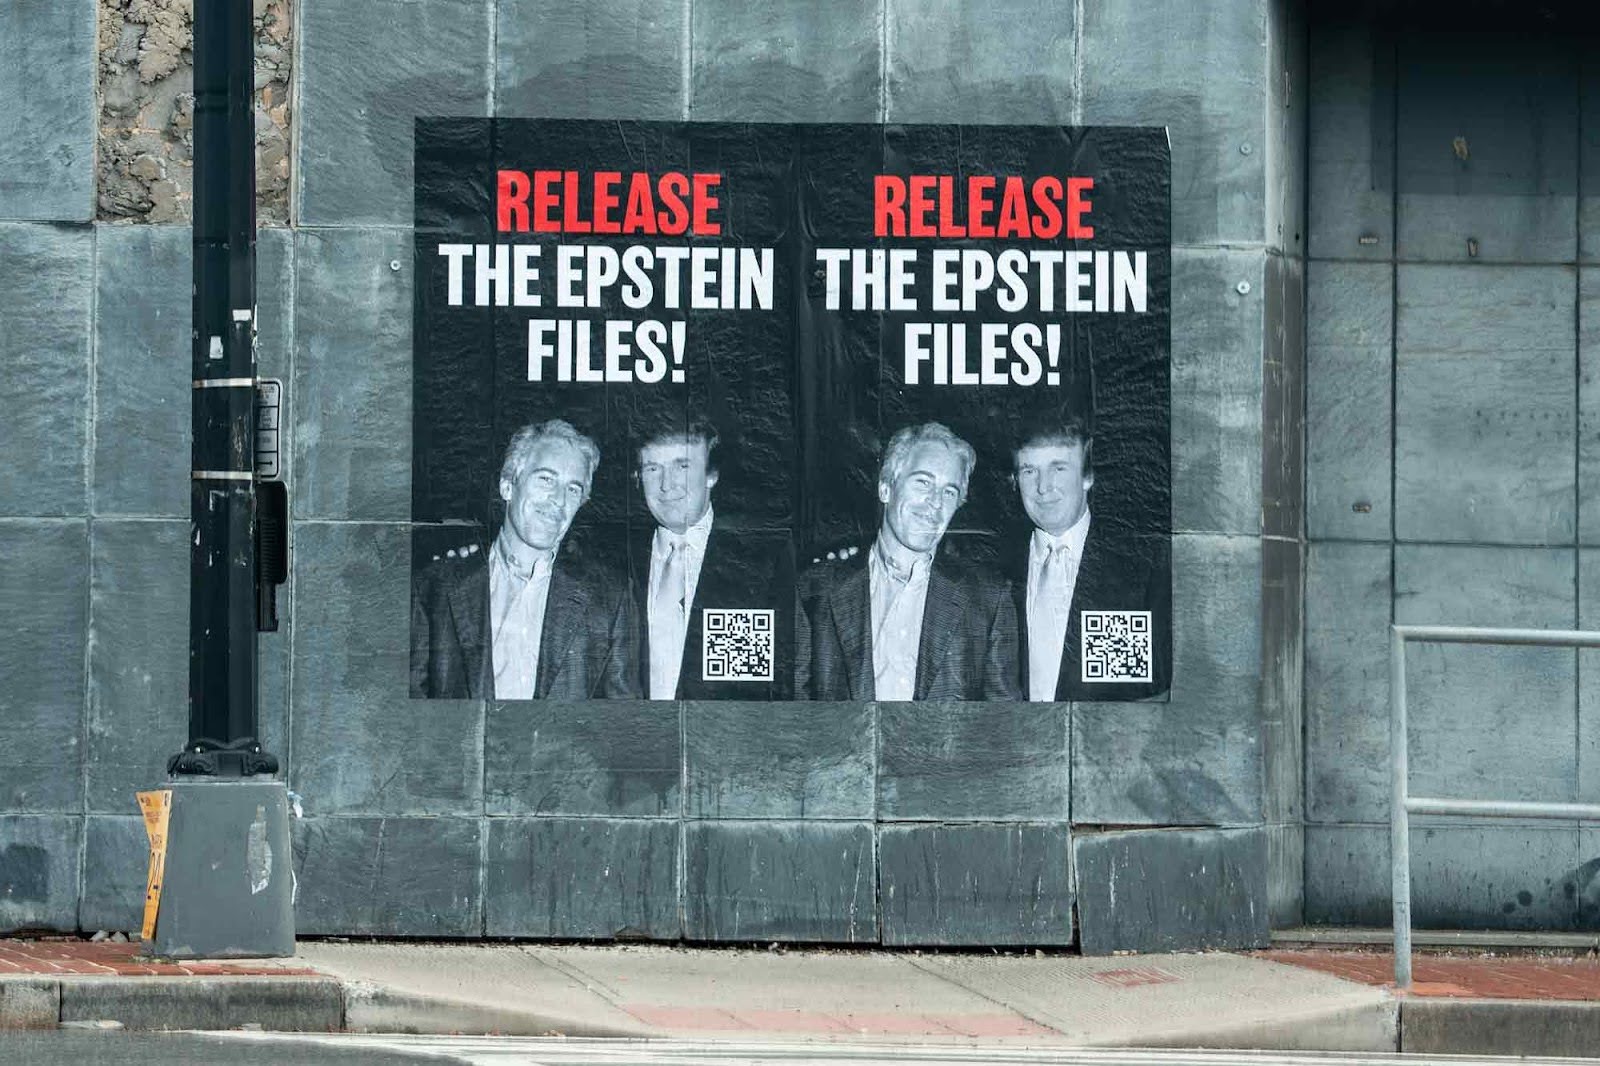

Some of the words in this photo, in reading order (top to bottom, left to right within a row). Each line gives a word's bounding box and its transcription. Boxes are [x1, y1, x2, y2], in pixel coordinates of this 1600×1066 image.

[497, 170, 721, 236] RELEASE
[875, 176, 1094, 240] RELEASE
[438, 243, 542, 307] THE
[557, 244, 774, 310] EPSTEIN
[816, 249, 918, 311] THE
[932, 250, 1148, 313] EPSTEIN
[527, 319, 686, 384] FILES!
[904, 323, 1061, 386] FILES!
